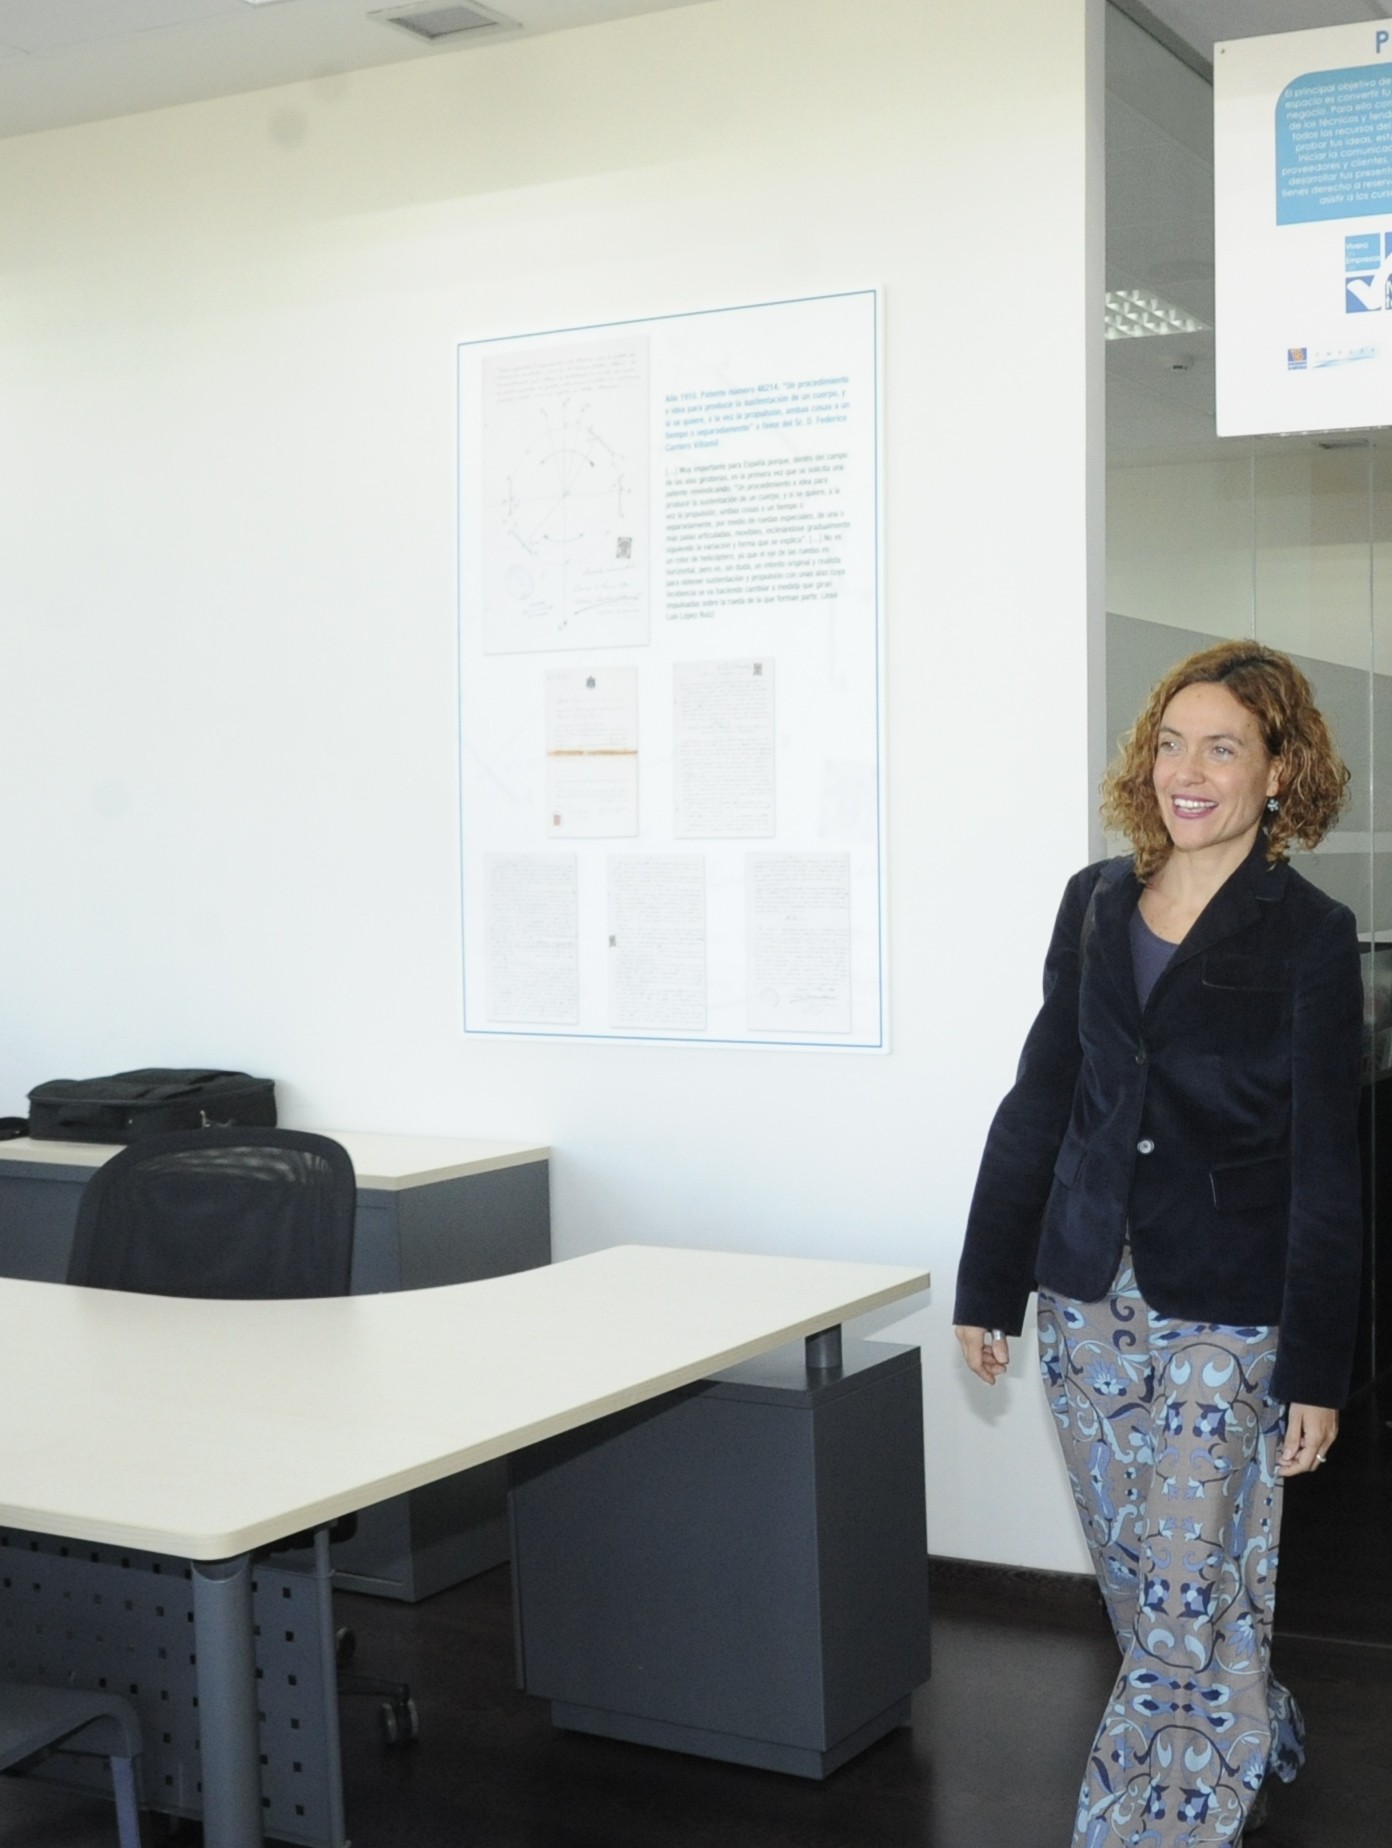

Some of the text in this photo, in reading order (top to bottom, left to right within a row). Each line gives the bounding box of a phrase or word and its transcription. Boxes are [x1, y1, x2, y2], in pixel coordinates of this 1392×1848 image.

[1285, 87, 1292, 97] El
[1294, 82, 1335, 98] principal
[1337, 80, 1376, 91] objetivo
[1378, 76, 1391, 86] de
